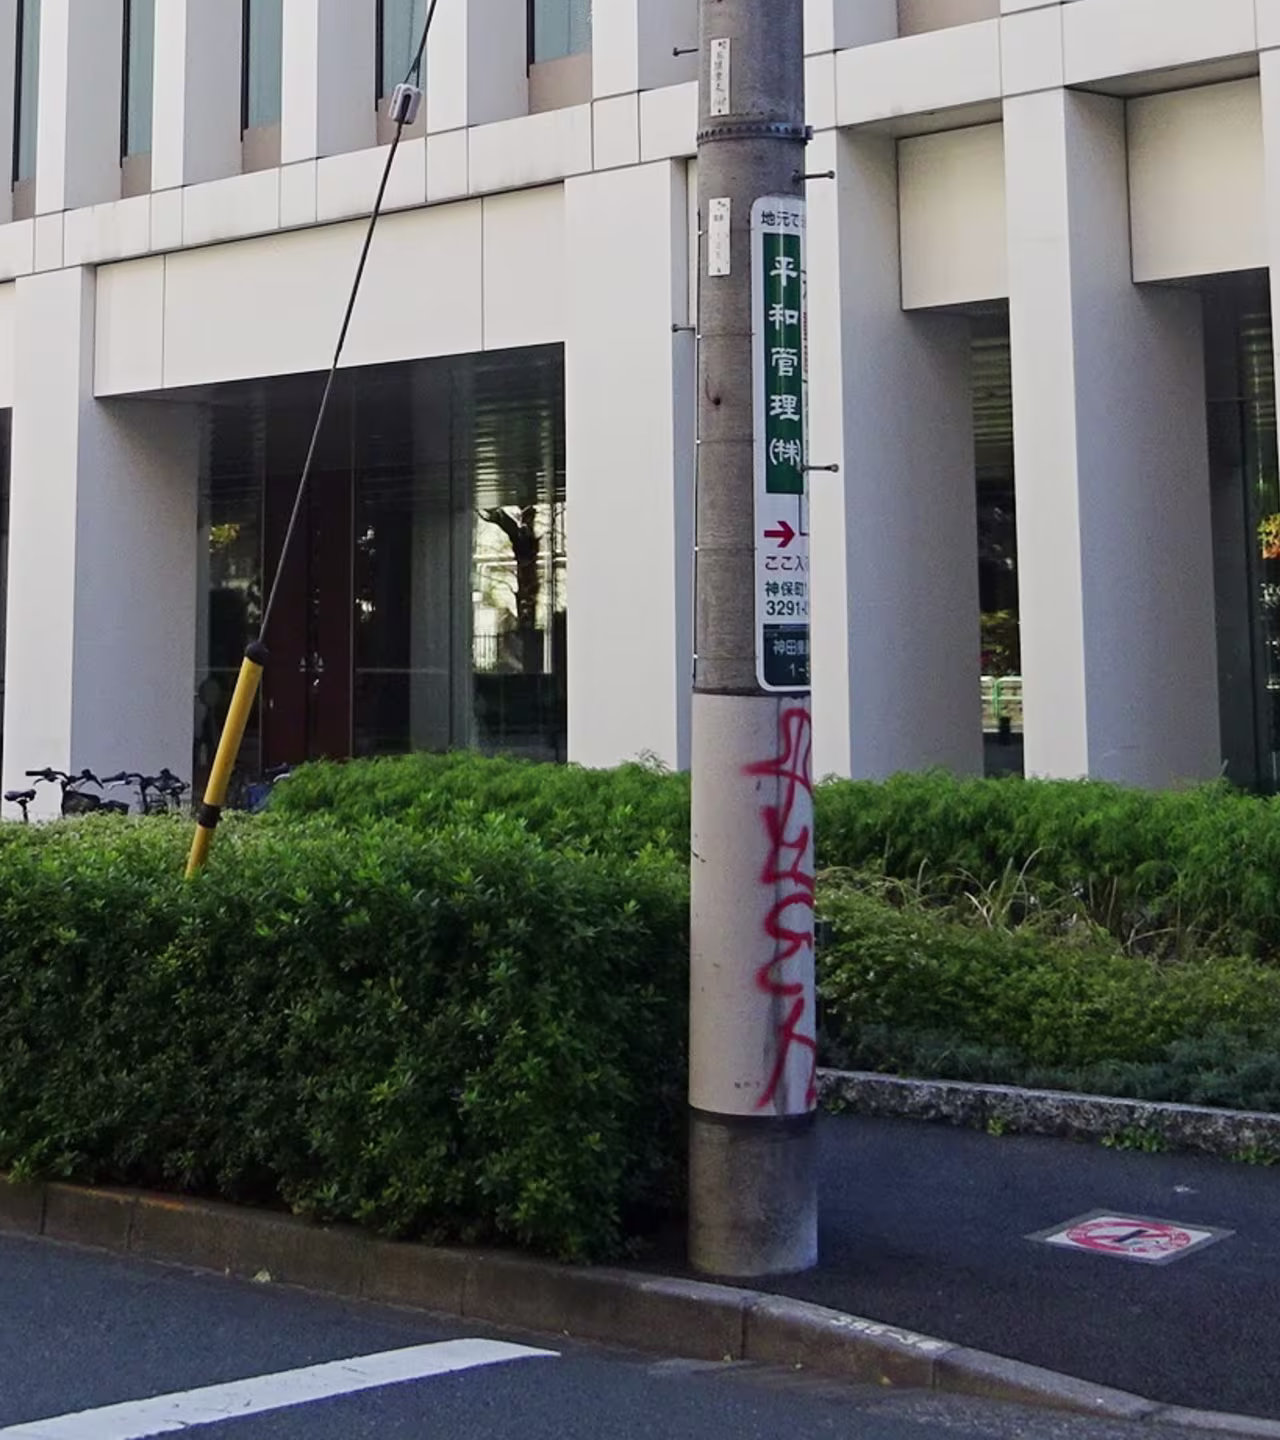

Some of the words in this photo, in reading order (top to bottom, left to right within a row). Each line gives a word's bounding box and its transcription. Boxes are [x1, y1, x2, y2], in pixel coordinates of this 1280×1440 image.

[768, 256, 801, 466] 平和管理(株)
[765, 555, 809, 571] ここ入
[765, 581, 808, 597] 神保町
